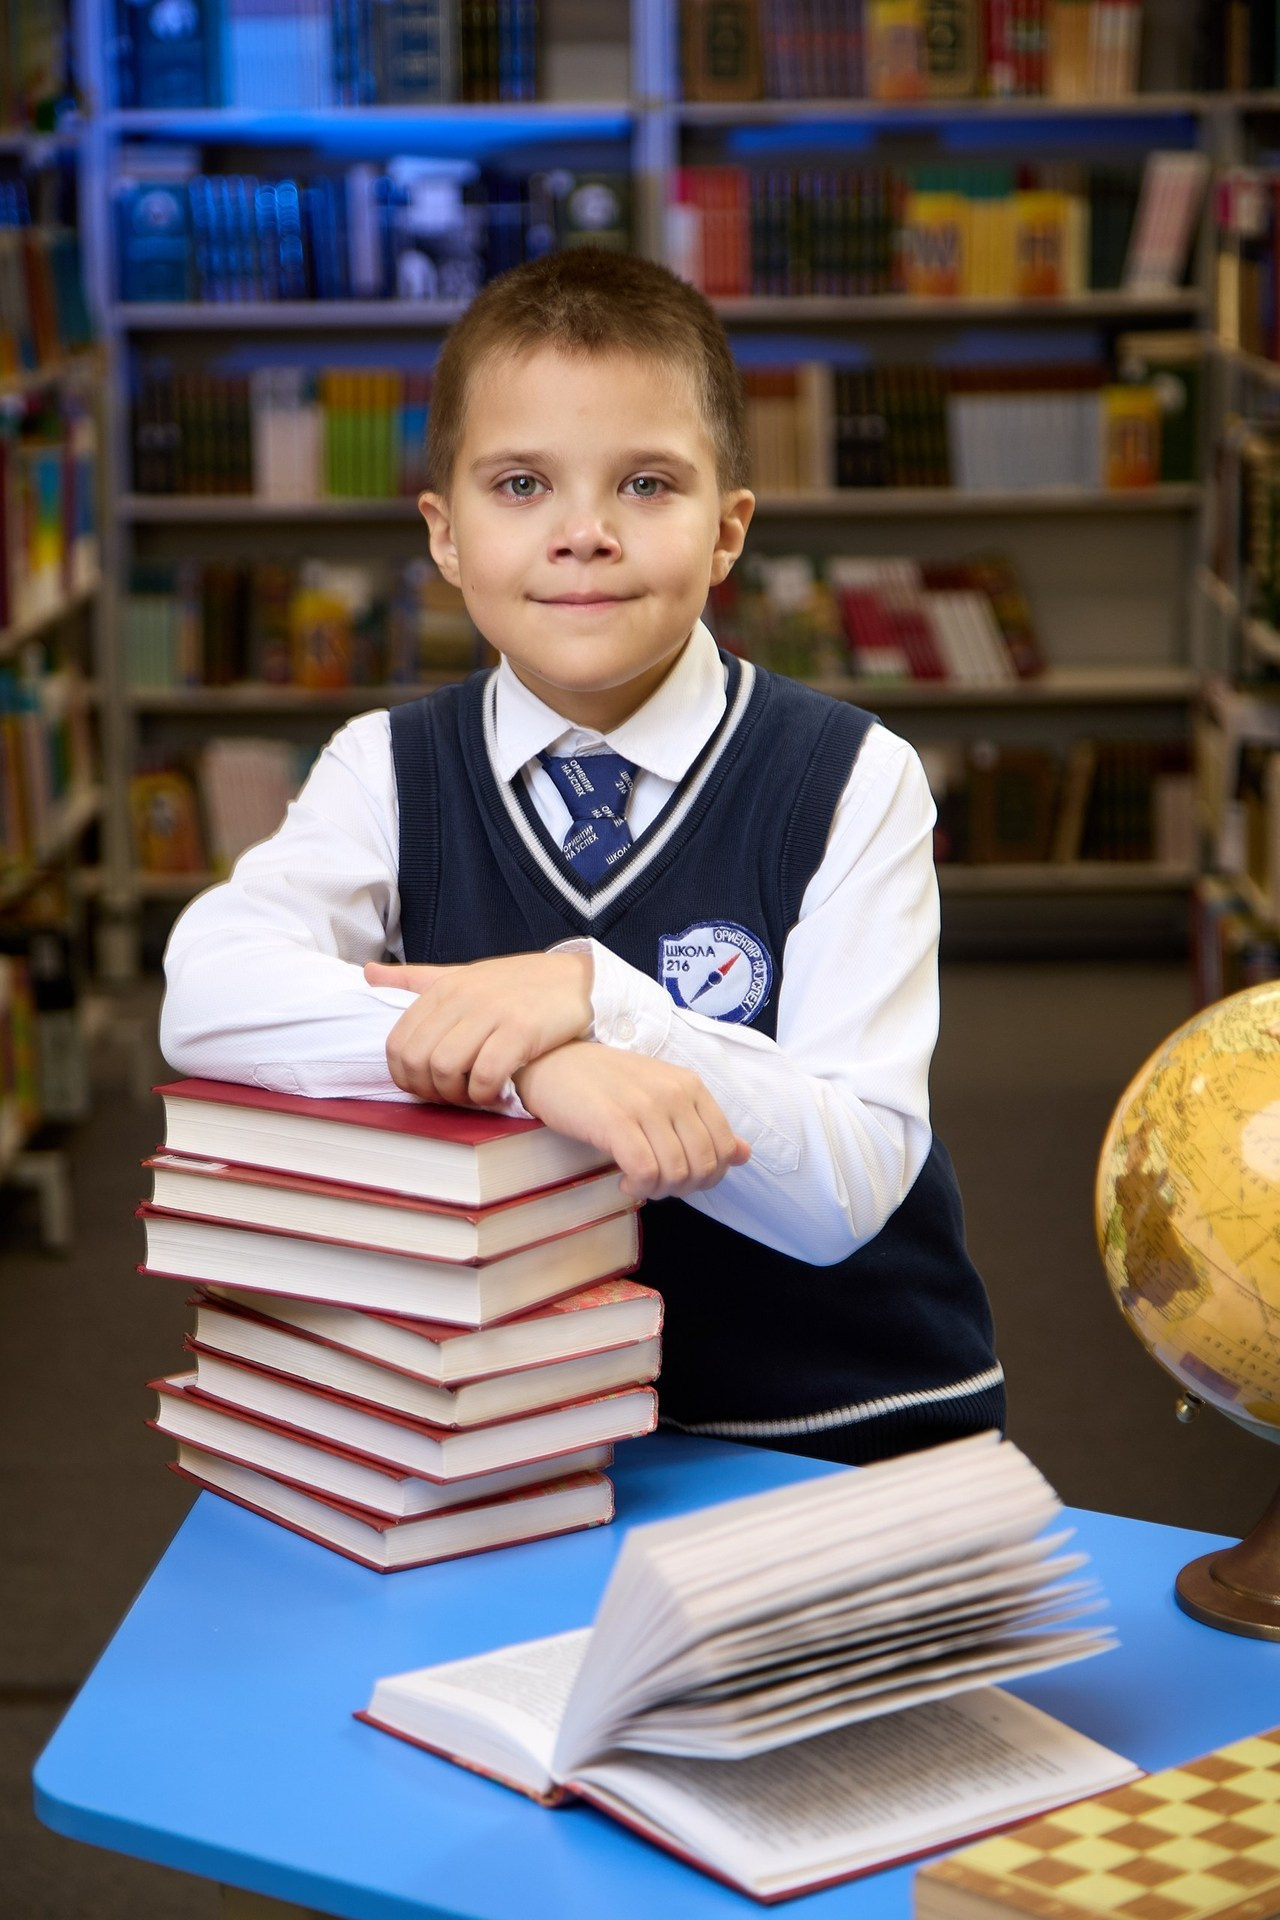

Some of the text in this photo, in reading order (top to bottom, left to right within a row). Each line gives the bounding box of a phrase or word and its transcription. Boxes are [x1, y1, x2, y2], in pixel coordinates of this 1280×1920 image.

[561, 763, 587, 798] НА УСПЕХ
[570, 759, 595, 792] ОРИЕНТИР
[615, 780, 628, 794] 216
[563, 825, 594, 853] ОРИЕНТИР
[565, 832, 599, 861] НА УСПЕХ
[666, 945, 716, 958] ШКОЛА
[666, 960, 690, 972] 216
[714, 929, 765, 1011] ОРИЕНТИР НА УСПЕХ
